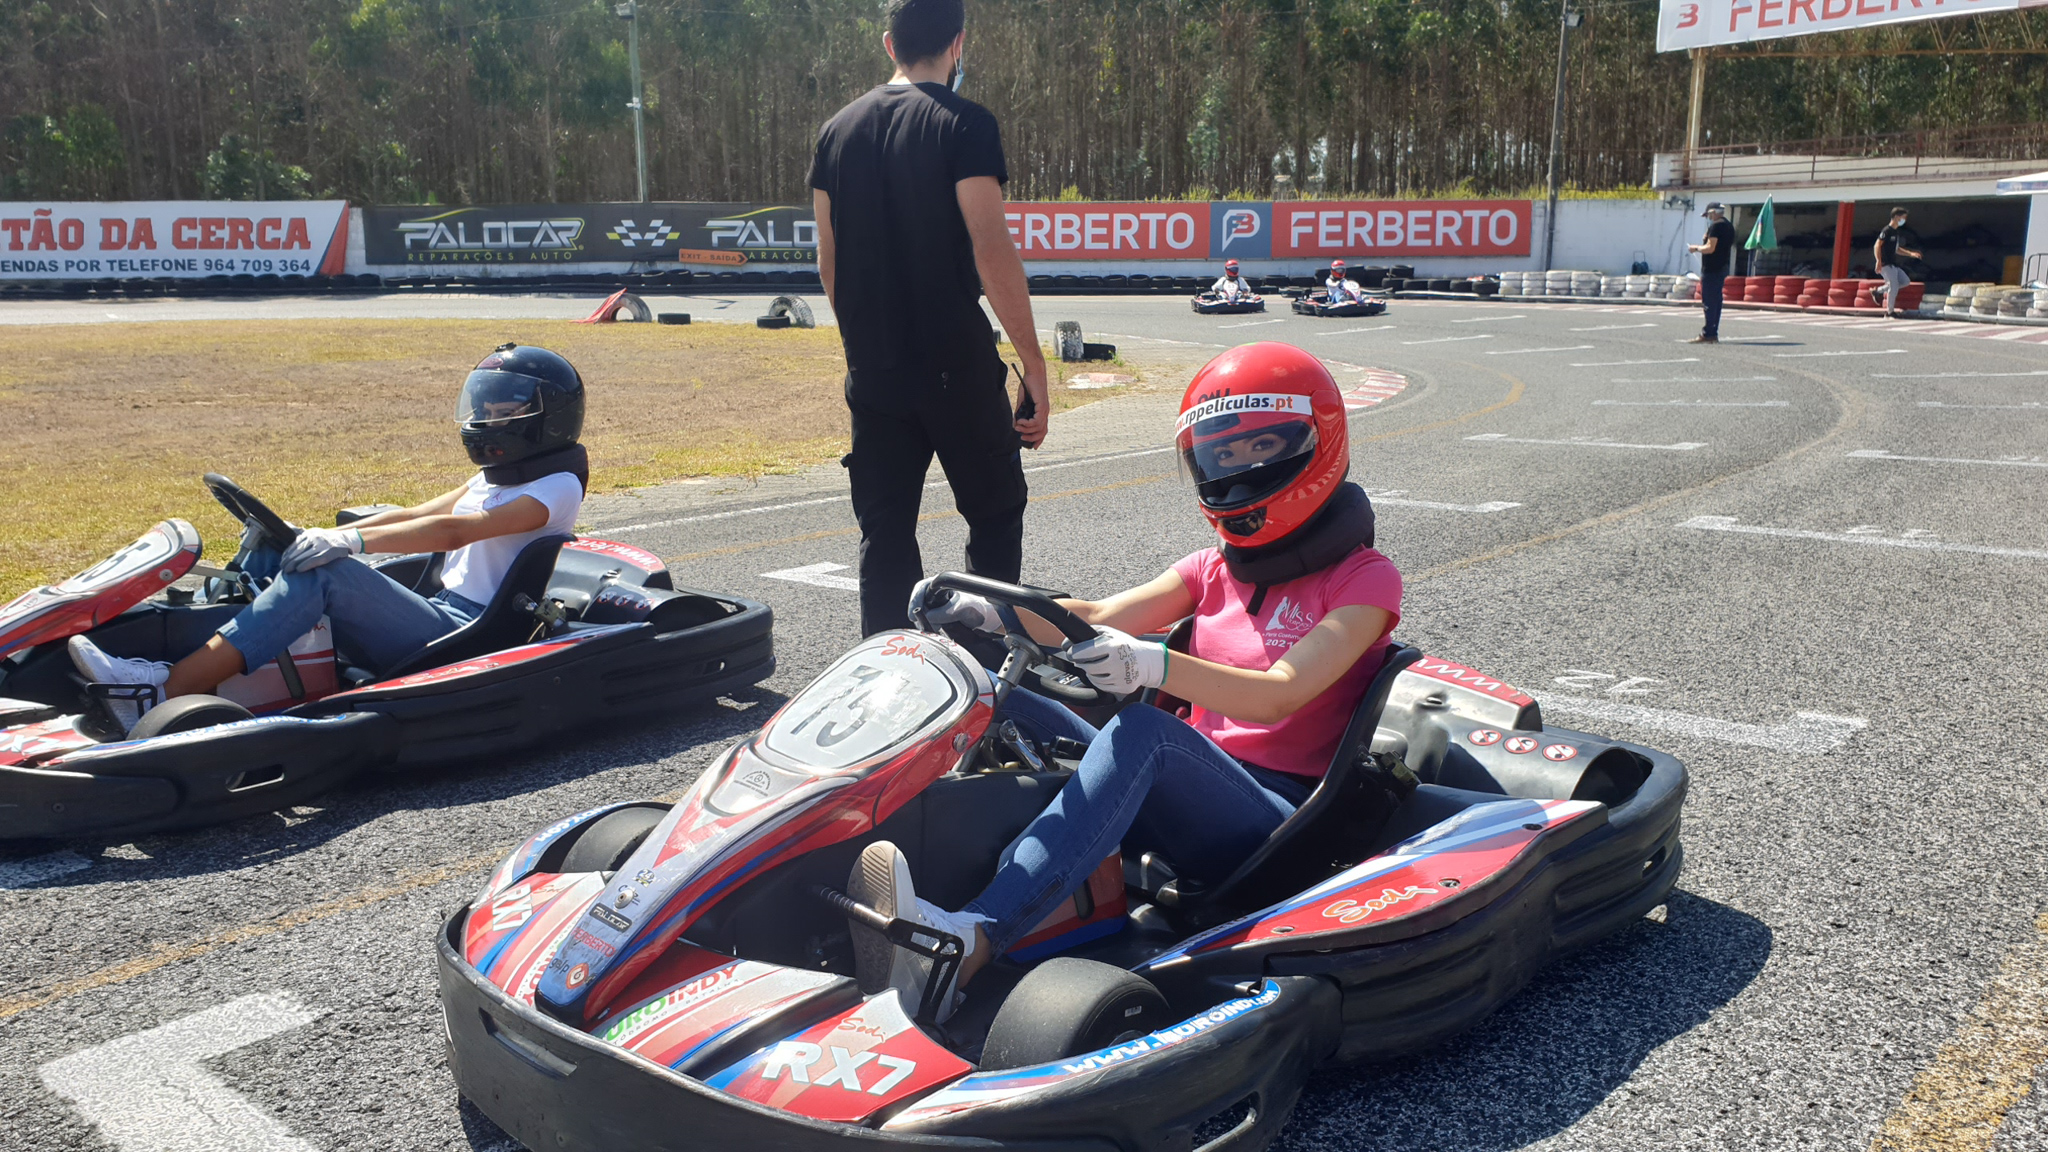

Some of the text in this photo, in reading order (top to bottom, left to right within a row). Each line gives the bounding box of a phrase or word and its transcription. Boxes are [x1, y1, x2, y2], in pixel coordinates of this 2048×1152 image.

[2, 208, 311, 251] TÃO DA CERCA
[399, 218, 584, 250] PALOCAR
[1291, 208, 1518, 248] FERBERTO
[1, 258, 311, 273] ENDAS POR TELEFONE 964 709 364
[408, 251, 573, 262] REPARAÇÕES AUTO
[710, 253, 737, 262] SAÍDA
[1265, 638, 1294, 650] 2021
[838, 1016, 887, 1042] Sodi
[763, 1040, 916, 1096] RX7
